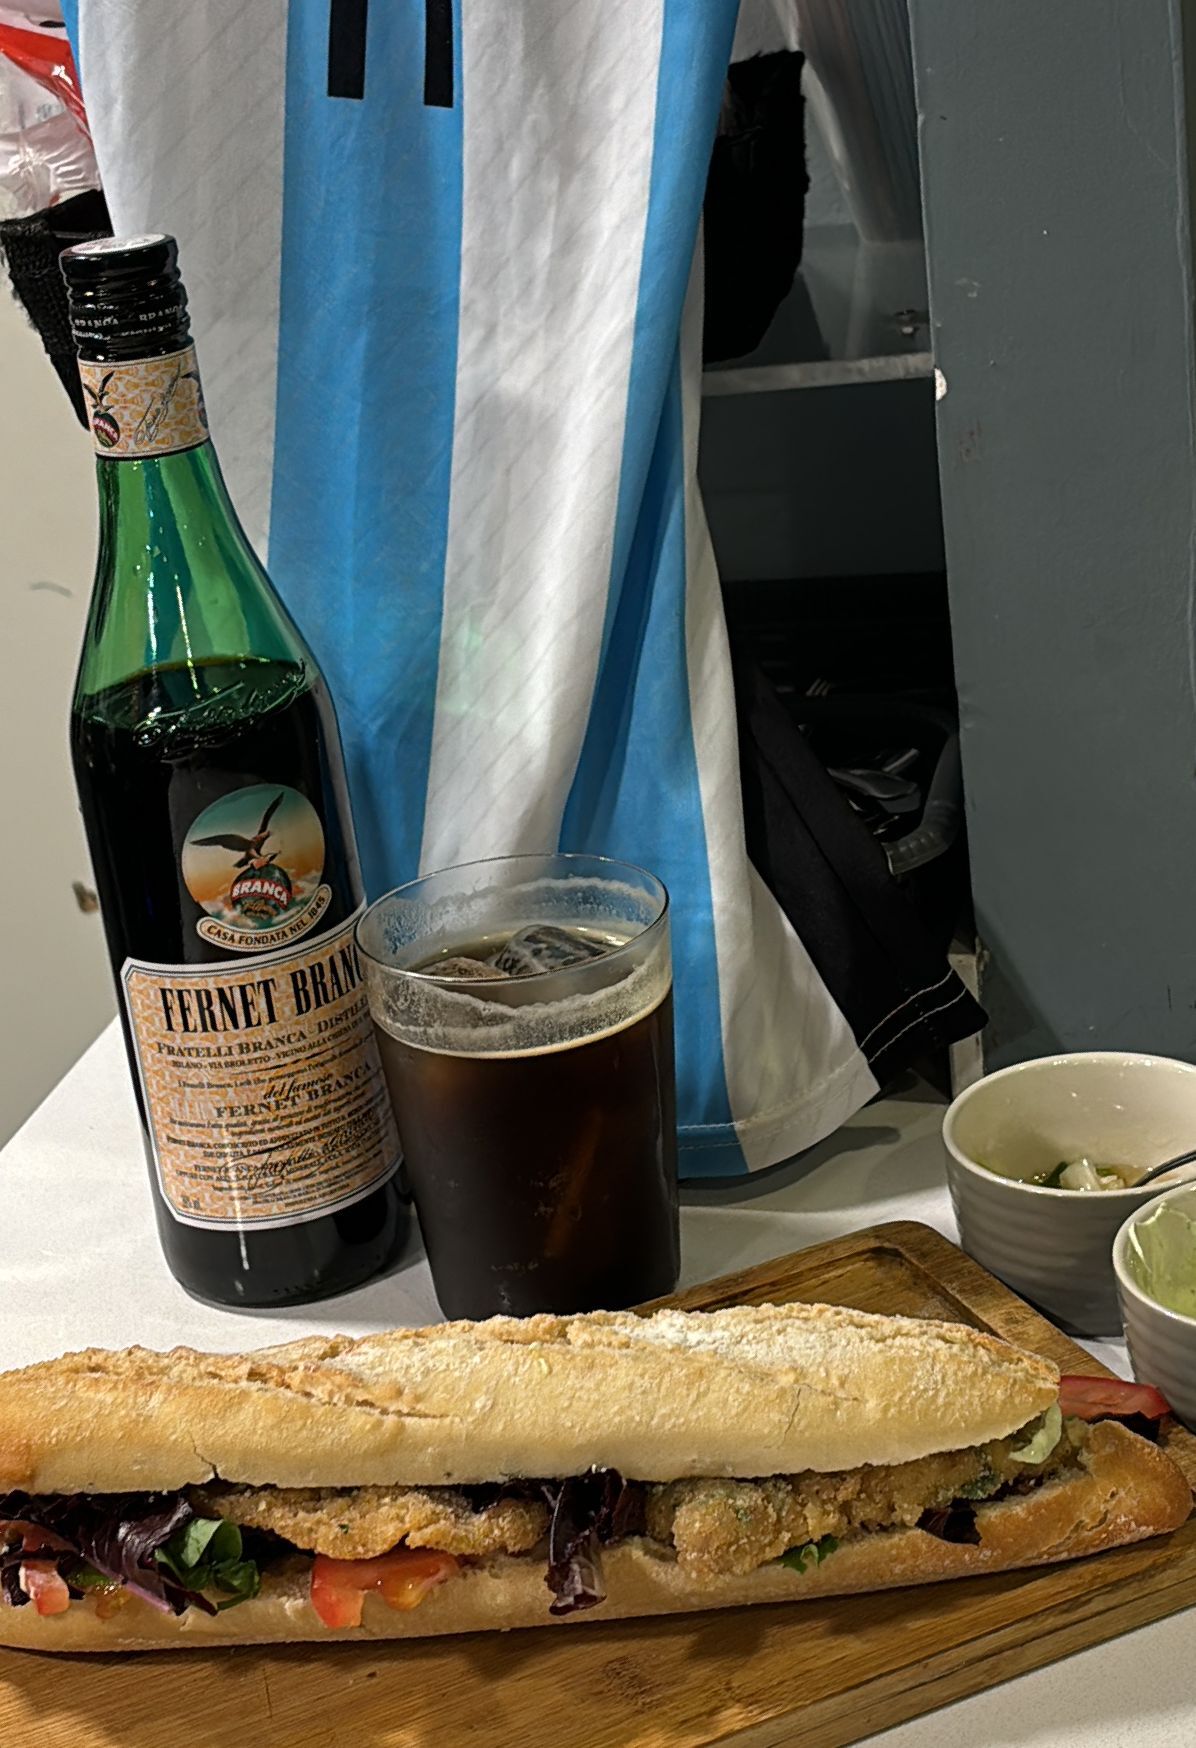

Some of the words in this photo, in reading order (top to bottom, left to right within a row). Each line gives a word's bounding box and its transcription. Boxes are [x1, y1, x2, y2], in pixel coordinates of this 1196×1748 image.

[232, 881, 288, 906] BRANCA
[207, 925, 235, 944] CASA
[239, 930, 288, 946] FONDATA
[289, 919, 308, 935] NEL
[307, 896, 325, 919] 1845
[159, 978, 277, 1033] FERNET
[156, 1041, 234, 1058] FRATELLI
[237, 1030, 307, 1056] BRANCA
[216, 1094, 301, 1118] FERNET
[306, 1060, 372, 1101] BRANCA
